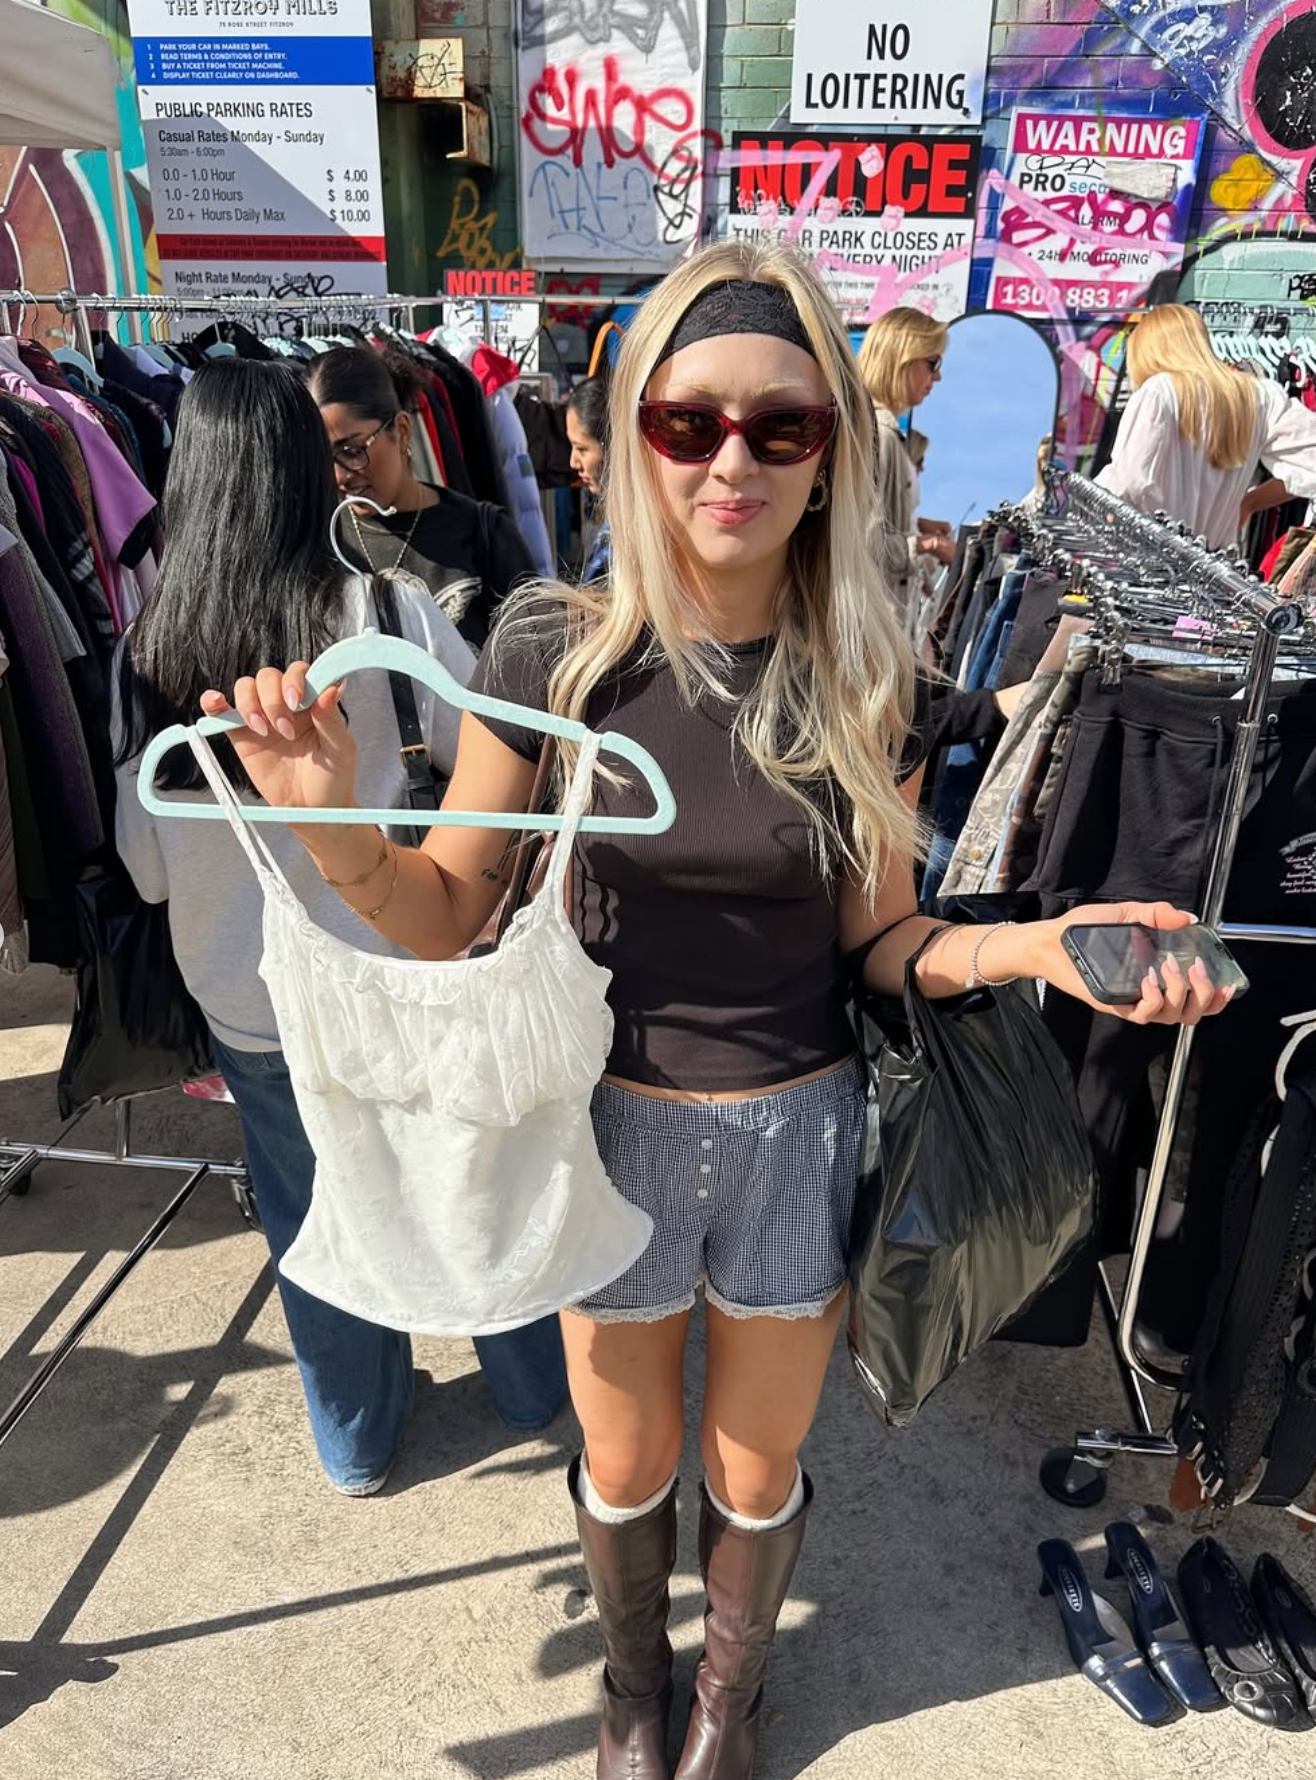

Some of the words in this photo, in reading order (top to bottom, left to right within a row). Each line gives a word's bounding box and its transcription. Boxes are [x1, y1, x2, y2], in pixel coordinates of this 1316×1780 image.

[165, 0, 198, 15] THE
[204, 0, 279, 15] FITZROY
[286, 0, 338, 15] MILLS
[866, 23, 911, 61] NO
[805, 72, 966, 110] LOITERING
[155, 102, 204, 118] PUBLIC
[207, 102, 265, 118] PARKING
[270, 101, 313, 118] RATES
[158, 130, 195, 143] Casual
[198, 130, 228, 143] Rates
[231, 130, 273, 146] Monday
[284, 130, 325, 145] Sunday
[1025, 119, 1187, 155] WARNING
[160, 147, 188, 157] 5:30am
[196, 147, 225, 159] 6:00pm
[162, 169, 180, 182] 0.0
[191, 169, 208, 182] 1.0
[211, 169, 235, 182] Hour
[326, 169, 334, 182] $
[343, 169, 368, 182] 4.00
[736, 140, 972, 213] NOTICE
[1019, 173, 1066, 193] PRO
[165, 188, 180, 201] 1.0
[193, 188, 210, 201] 2.0
[212, 188, 243, 201] Hours
[328, 189, 336, 202] $
[345, 189, 369, 202] 8.00
[167, 208, 184, 221] 2.0
[202, 208, 232, 221] Hours
[235, 208, 261, 225] Daily
[263, 209, 286, 221] Max
[329, 209, 337, 222] $
[340, 210, 370, 222] 10.00
[777, 229, 813, 248] CR
[819, 229, 866, 249] PARK
[870, 231, 938, 250] CLOSES
[943, 233, 967, 251] AT
[891, 254, 943, 275] NIGHT
[175, 271, 203, 285] Night
[205, 272, 229, 283] Rate
[231, 272, 273, 287] Monday
[446, 270, 536, 295] NOTICE
[1066, 287, 1110, 307] 883
